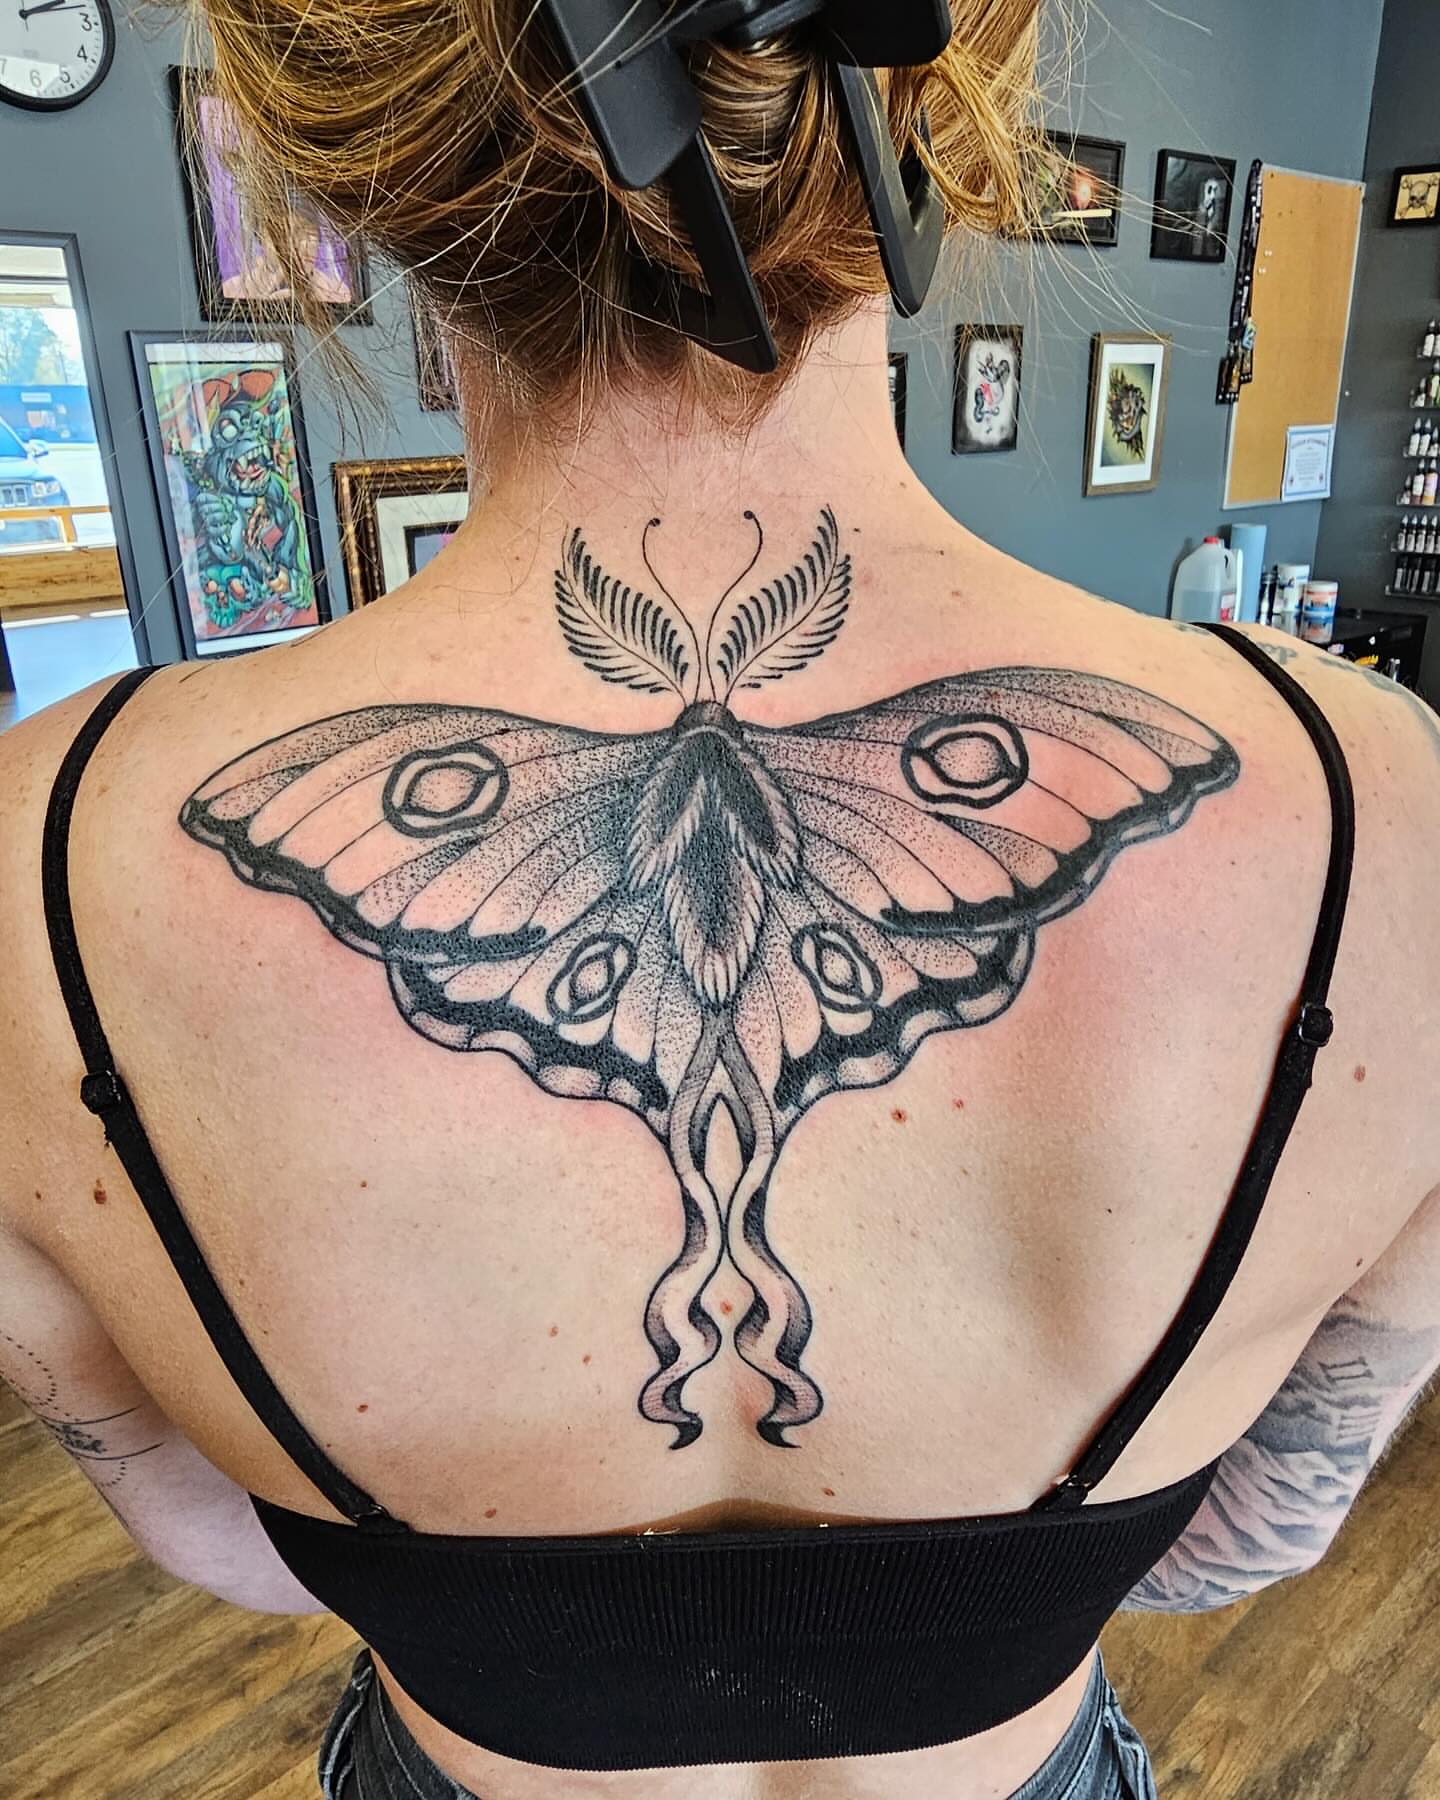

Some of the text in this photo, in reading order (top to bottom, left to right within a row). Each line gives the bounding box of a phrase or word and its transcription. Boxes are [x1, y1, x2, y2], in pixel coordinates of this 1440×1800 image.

[79, 12, 93, 32] 3
[77, 44, 88, 63] 4
[30, 70, 42, 88] 6
[59, 64, 71, 84] 5
